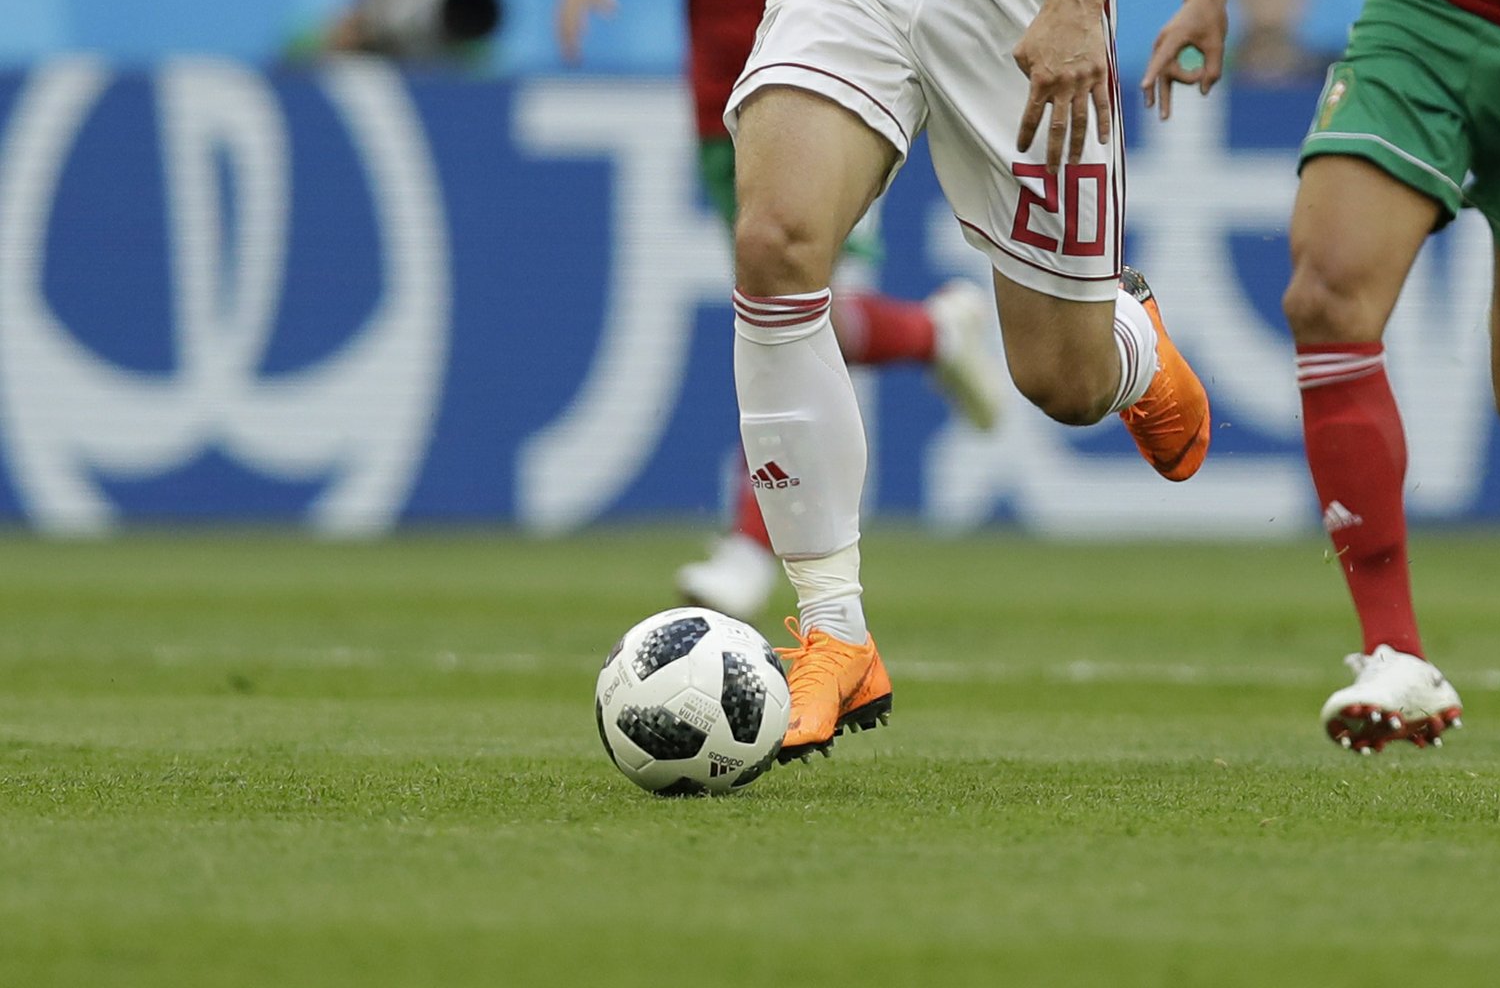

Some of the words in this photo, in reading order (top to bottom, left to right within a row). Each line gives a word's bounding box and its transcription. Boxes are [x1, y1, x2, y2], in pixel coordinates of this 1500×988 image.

[1011, 162, 1108, 256] 20
[678, 707, 713, 733] TELSTAR
[707, 751, 744, 768] adidas
